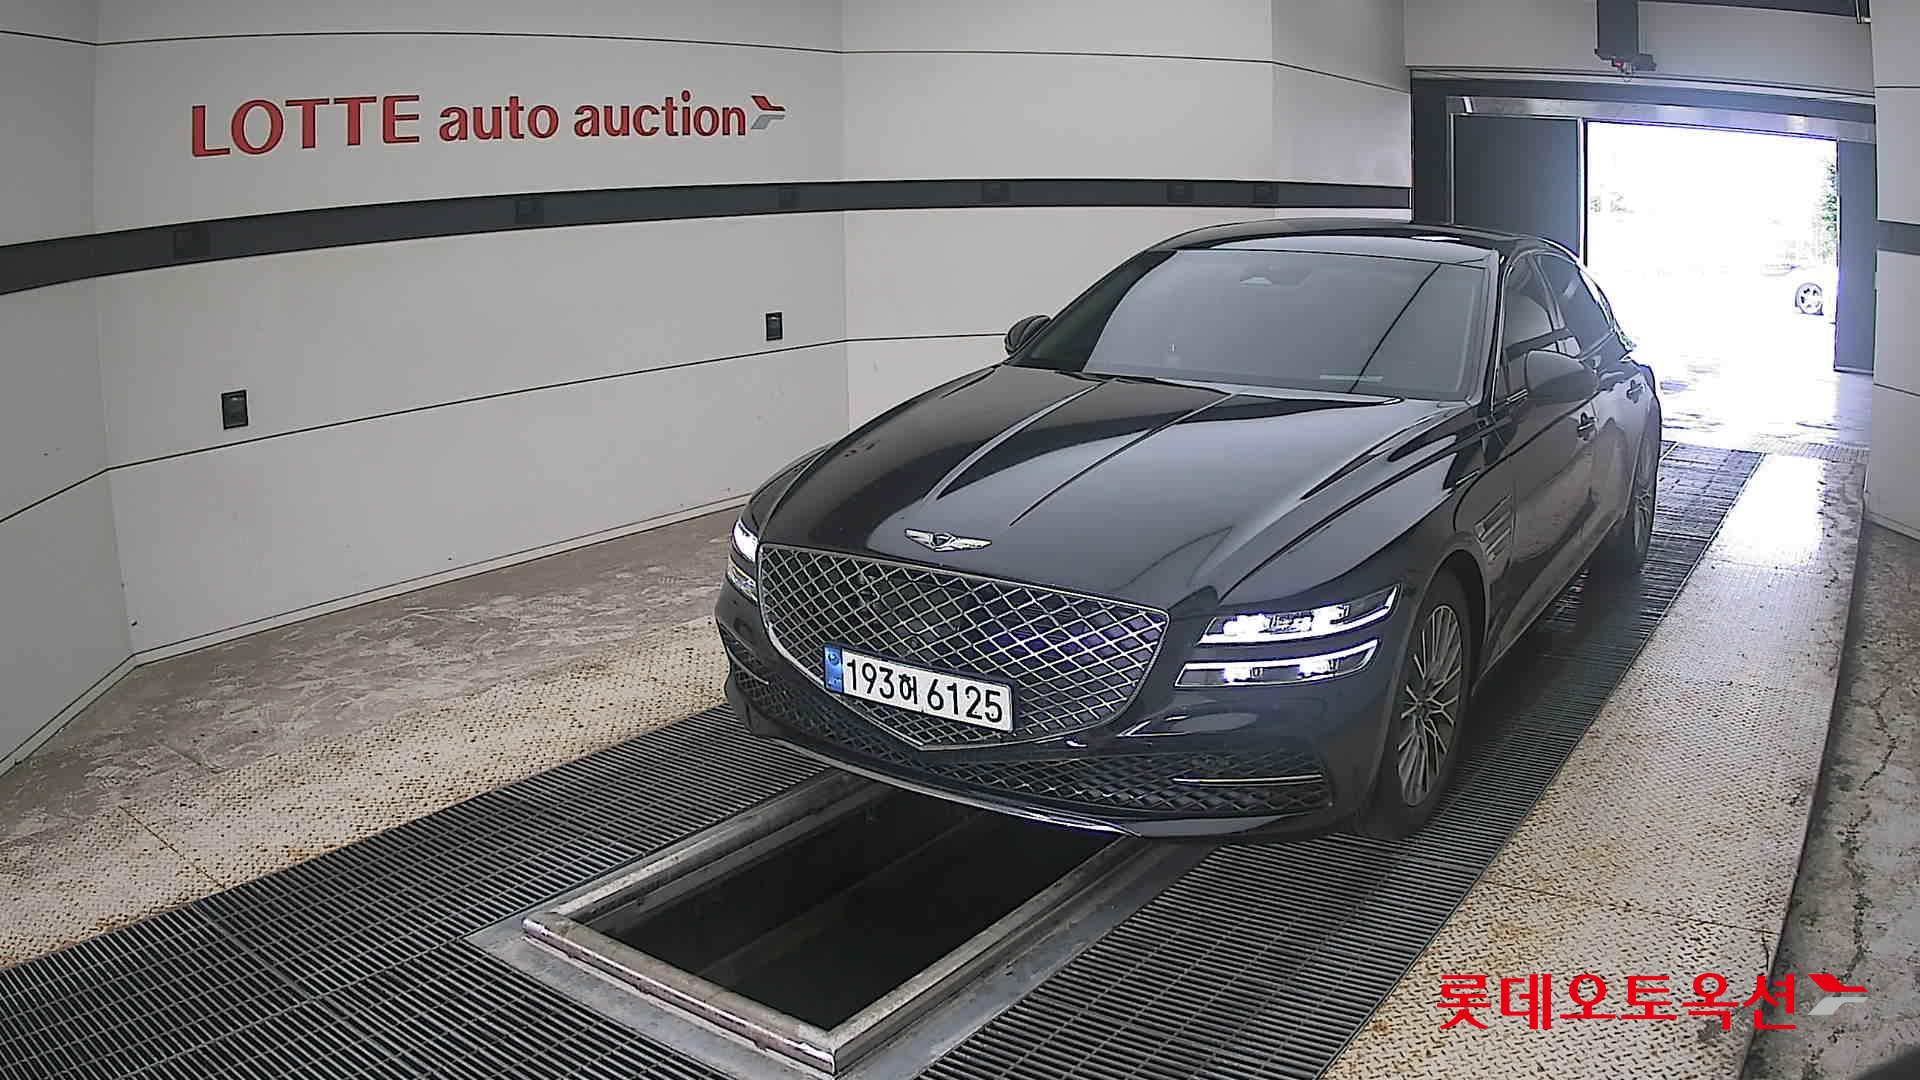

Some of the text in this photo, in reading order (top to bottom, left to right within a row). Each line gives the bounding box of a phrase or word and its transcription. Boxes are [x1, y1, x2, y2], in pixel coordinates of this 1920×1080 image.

[191, 90, 746, 157] LOTTE auto auction
[926, 678, 1002, 723] 6125
